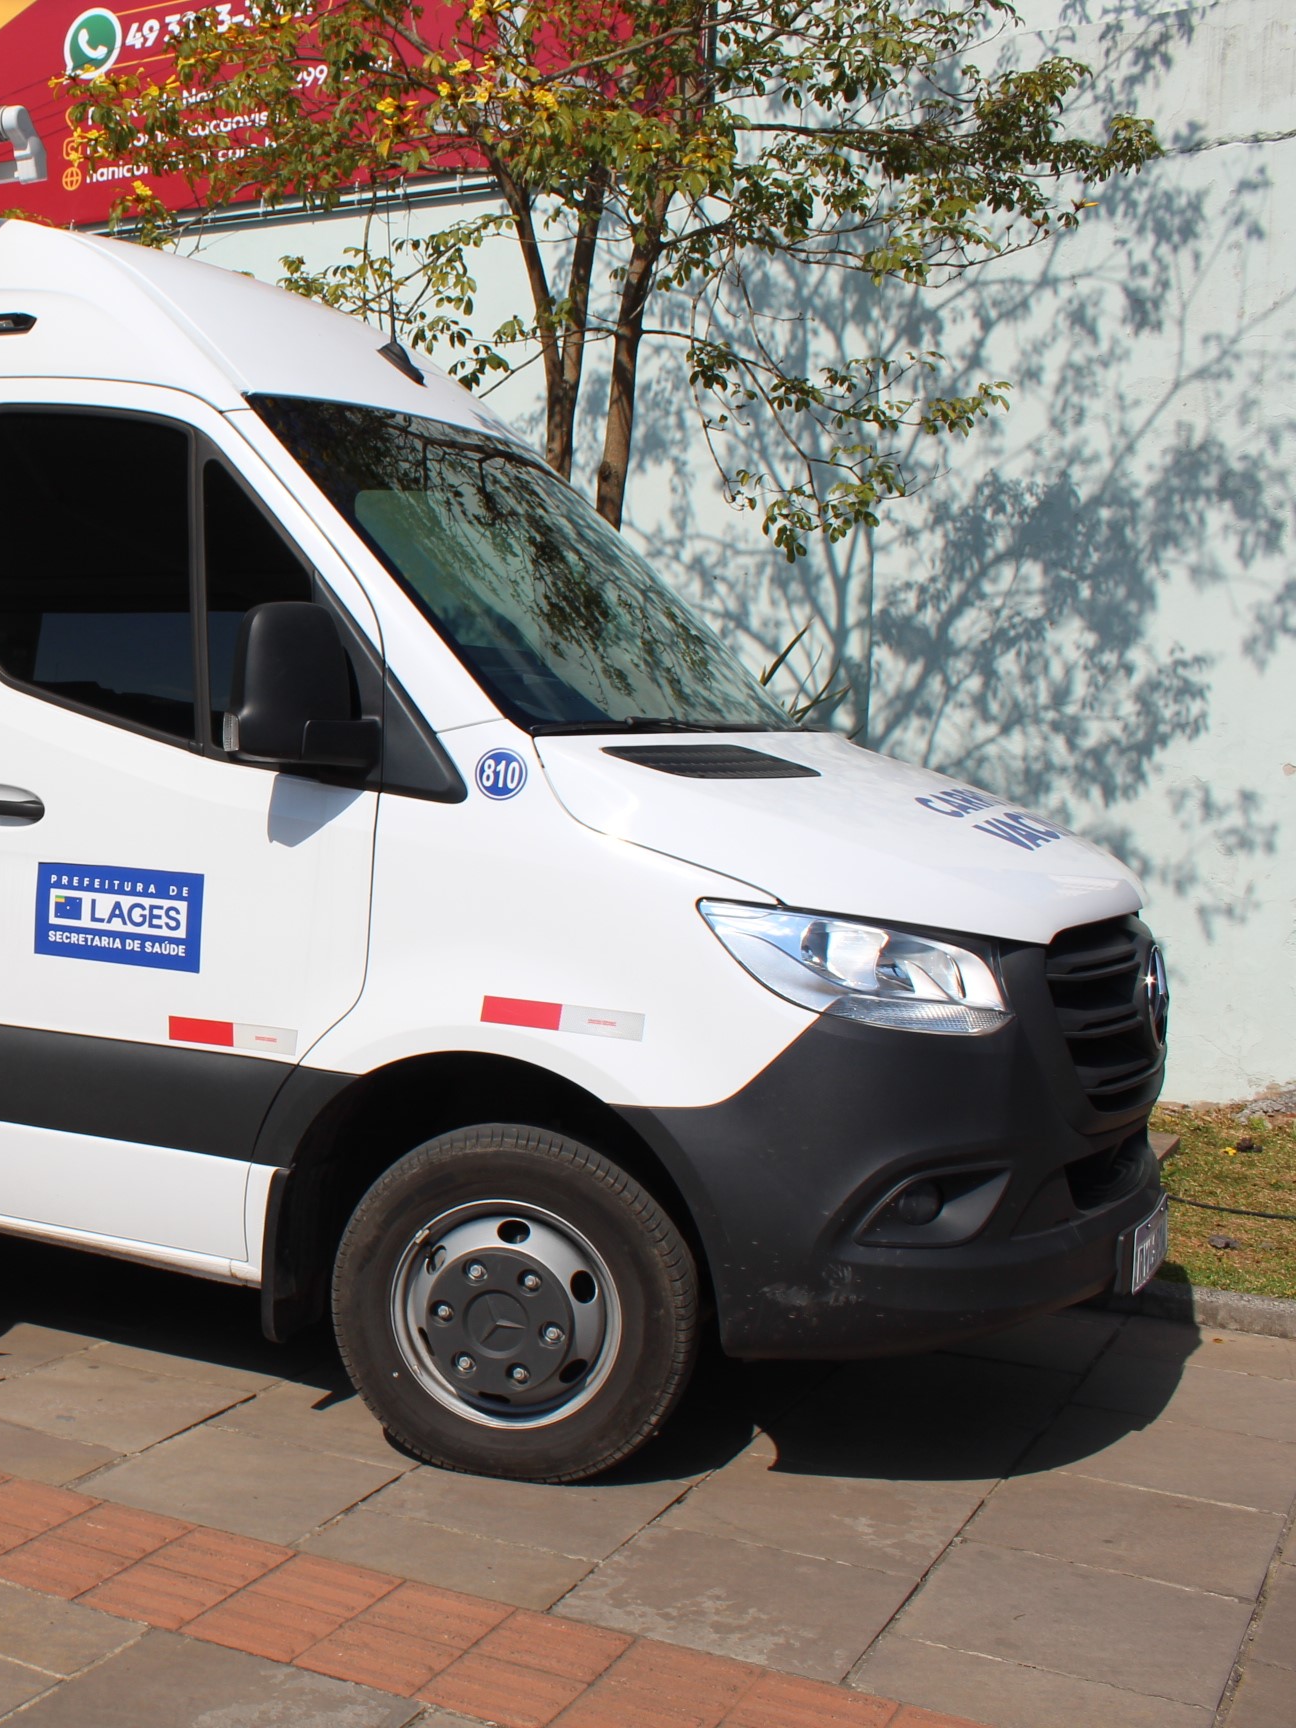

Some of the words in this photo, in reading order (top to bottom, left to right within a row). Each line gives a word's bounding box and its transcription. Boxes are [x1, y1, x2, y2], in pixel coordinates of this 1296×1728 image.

[125, 19, 160, 49] 49
[482, 758, 520, 790] 810
[50, 874, 156, 894] PREFEITURA
[169, 886, 189, 897] DE
[90, 898, 181, 931] LAGES
[48, 931, 122, 949] SECRETARIA
[125, 939, 141, 951] DE
[144, 941, 186, 957] SAÚDE
